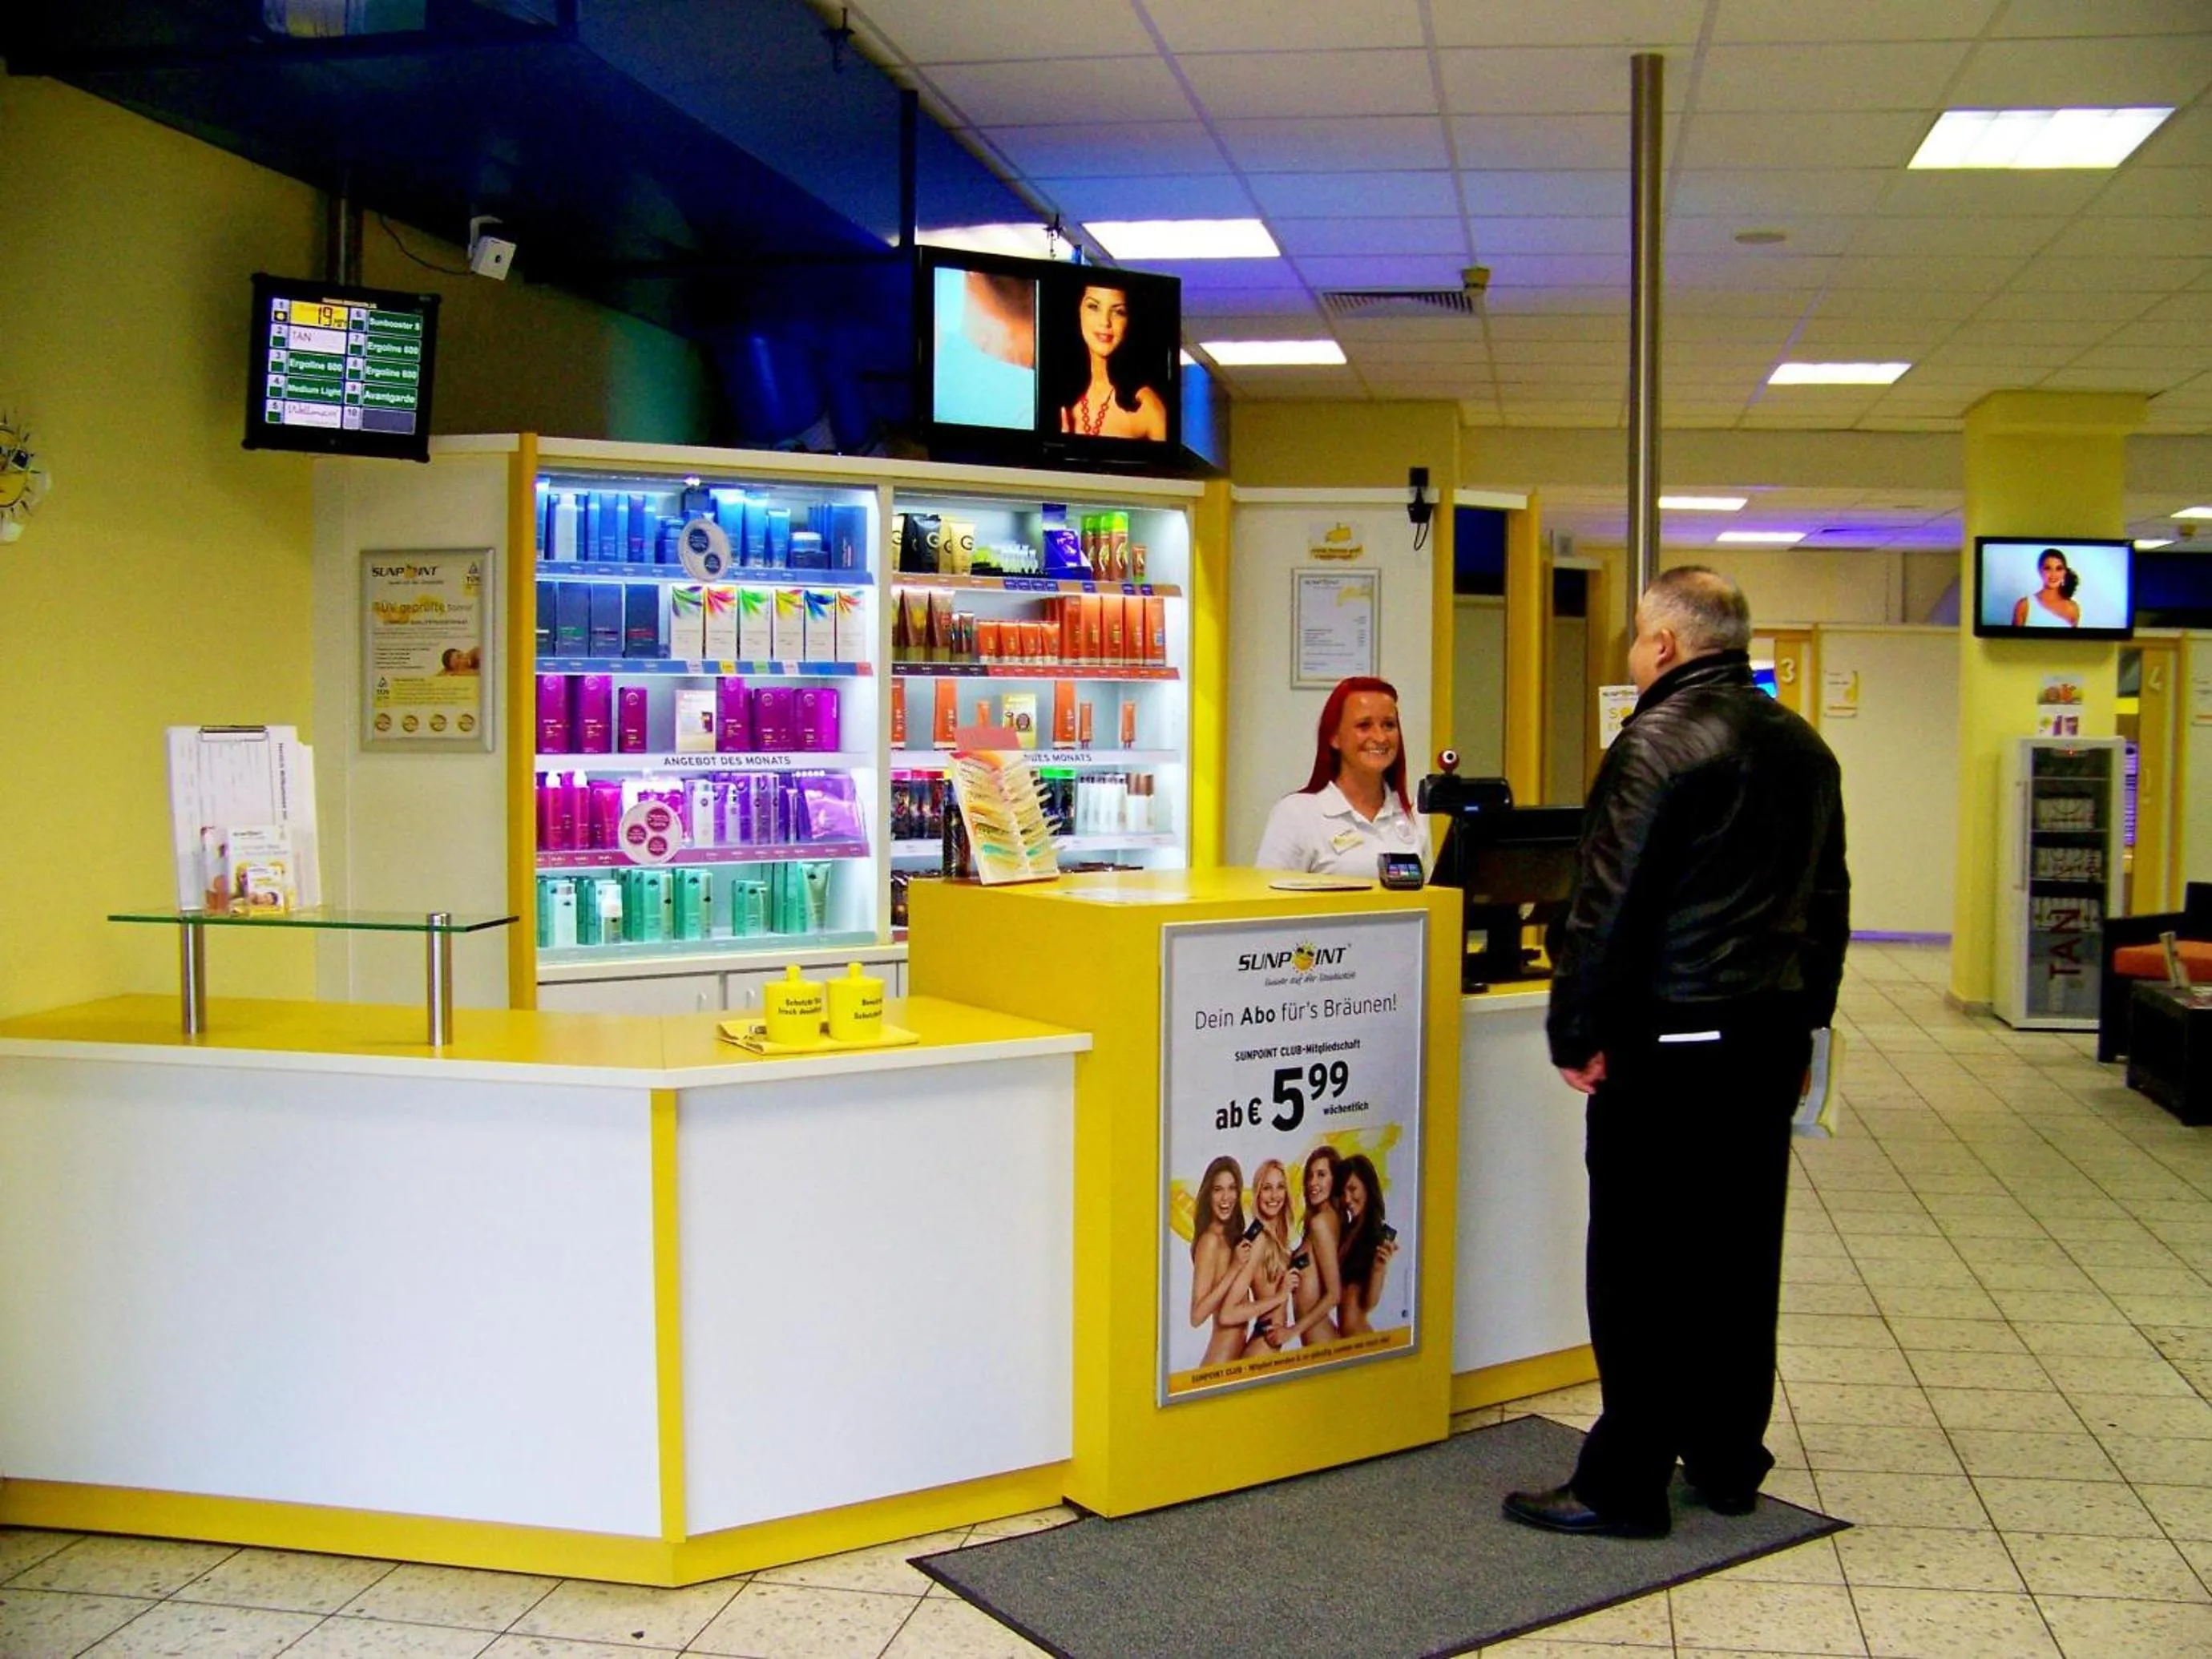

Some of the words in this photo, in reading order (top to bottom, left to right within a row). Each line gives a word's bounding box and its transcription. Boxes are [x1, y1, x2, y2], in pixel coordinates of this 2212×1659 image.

[318, 306, 333, 326] 19
[347, 408, 357, 417] 10
[1781, 658, 1794, 683] 3
[664, 756, 716, 766] ANGEBOT
[721, 756, 742, 766] DES
[745, 756, 792, 765] MONATS
[1052, 753, 1092, 762] MONATS
[2049, 908, 2082, 980] TAN
[1195, 1009, 1234, 1030] Dein
[1241, 1006, 1276, 1026] Abo
[1282, 1000, 1318, 1022] für's
[1324, 994, 1398, 1018] Bräunen!
[1235, 1047, 1278, 1062] SUNPOINT
[1216, 1100, 1243, 1130] ab
